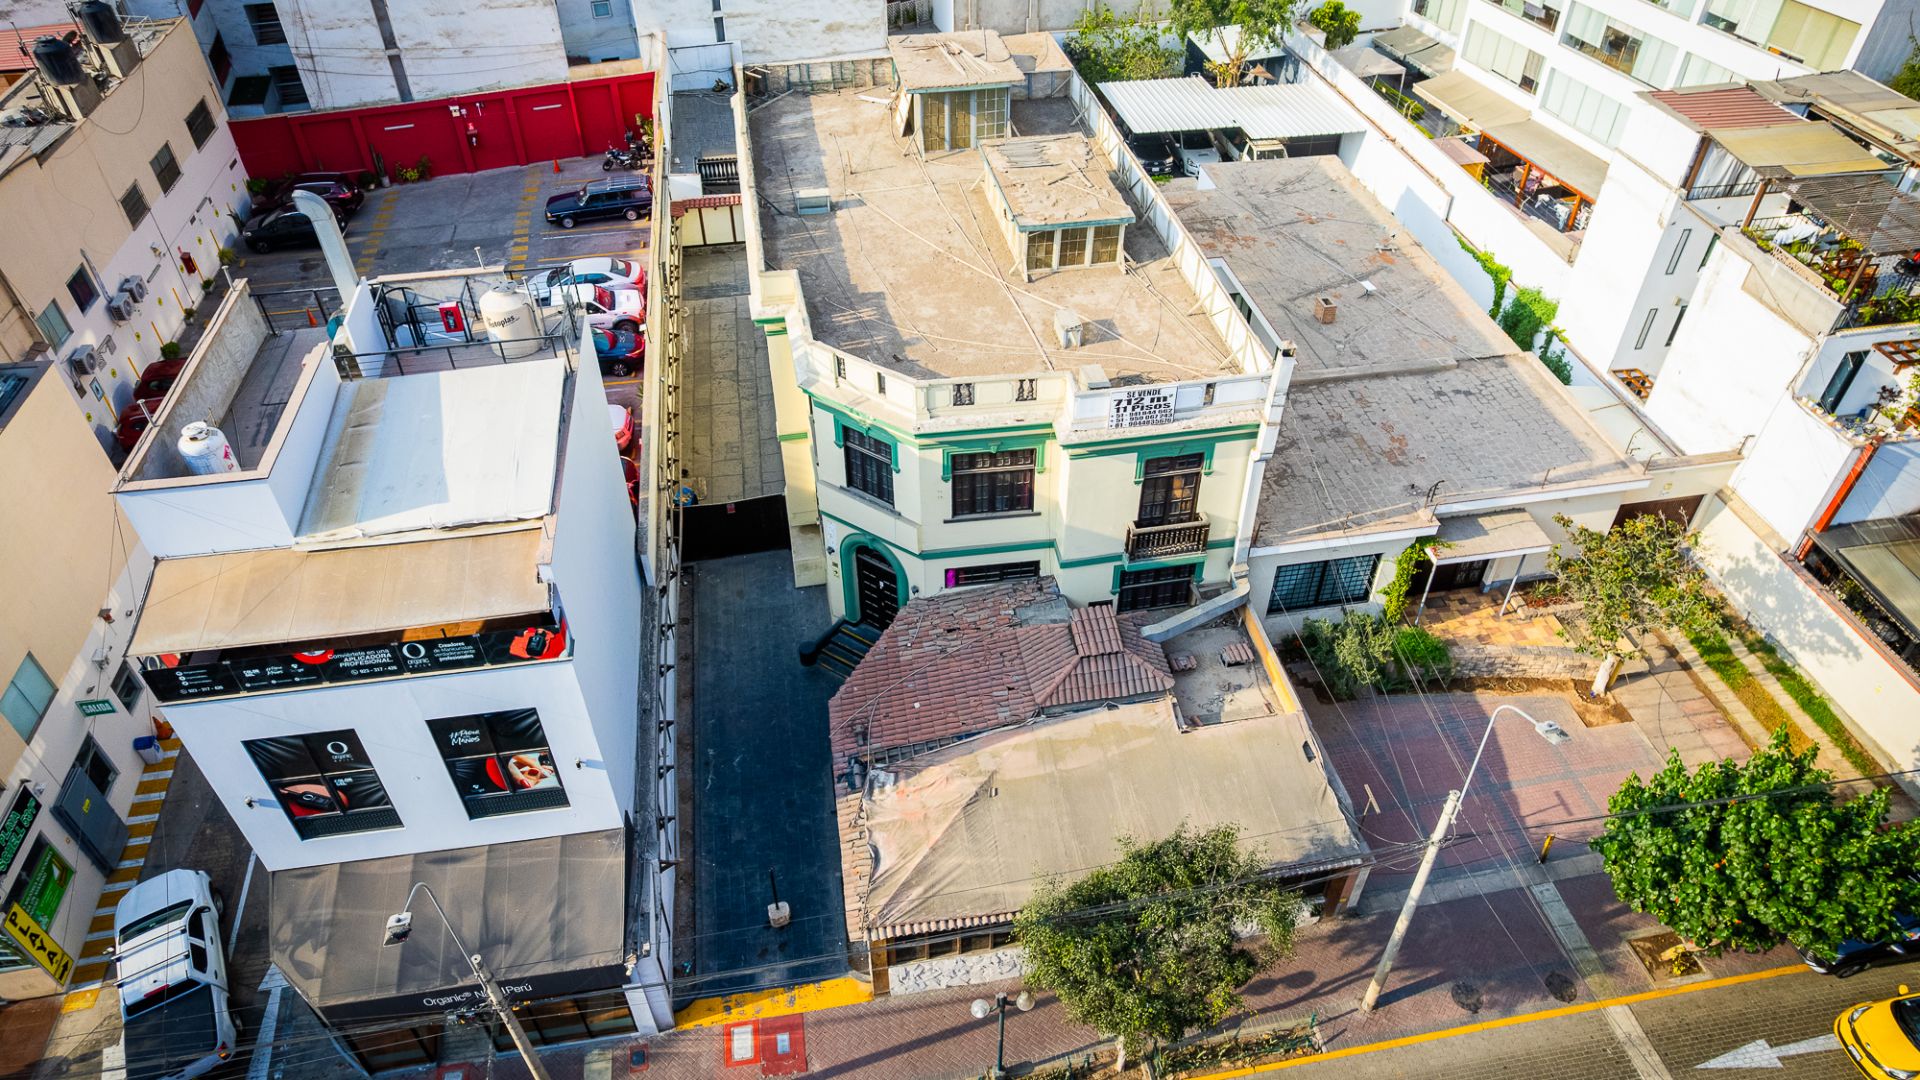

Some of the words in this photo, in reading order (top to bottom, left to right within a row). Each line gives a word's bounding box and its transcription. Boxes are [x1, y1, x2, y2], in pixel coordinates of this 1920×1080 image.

[1138, 389, 1161, 397] VENDE
[1113, 397, 1144, 407] 712
[343, 653, 392, 662] APLICADORA
[82, 702, 112, 714] SALIDA
[9, 911, 58, 967] PLAYA
